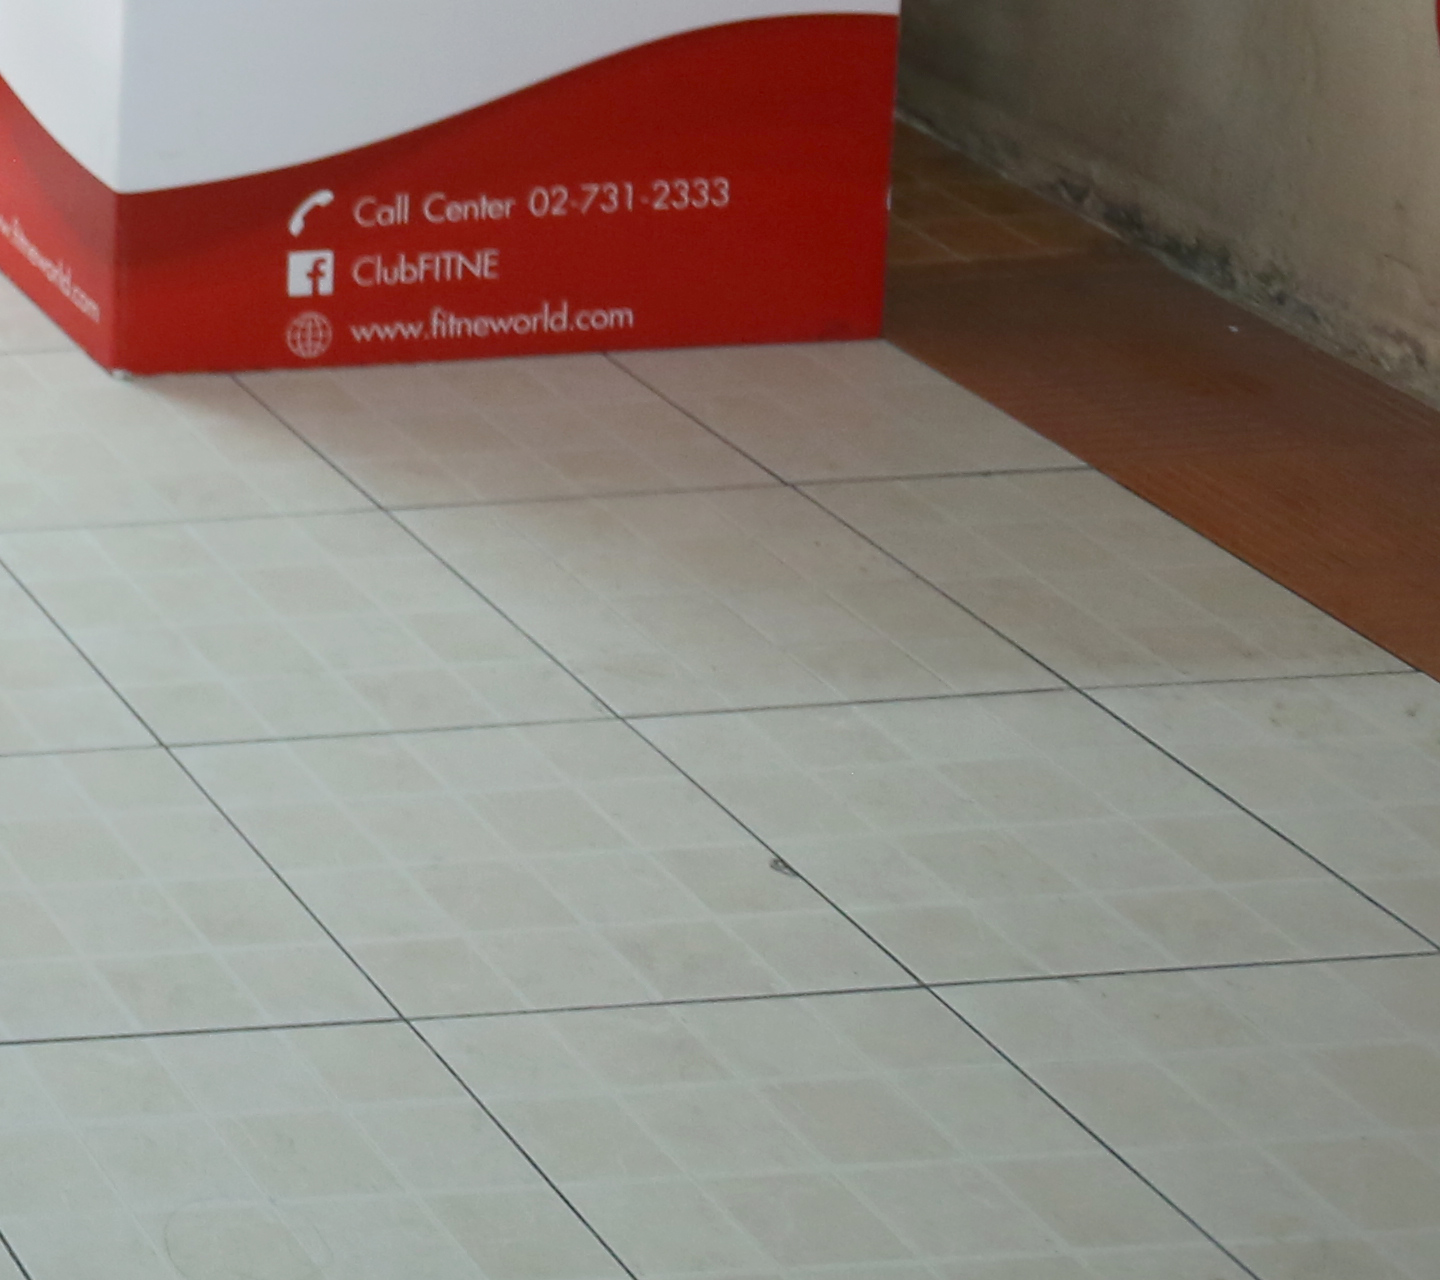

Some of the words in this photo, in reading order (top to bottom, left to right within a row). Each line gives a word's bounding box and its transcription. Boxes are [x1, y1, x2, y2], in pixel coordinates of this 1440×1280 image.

[352, 193, 410, 228] Call
[422, 188, 516, 223] Center
[528, 177, 731, 218] 02-731-2333
[351, 248, 500, 288] ClubFITNE
[349, 300, 635, 345] www.fitneworld.com
